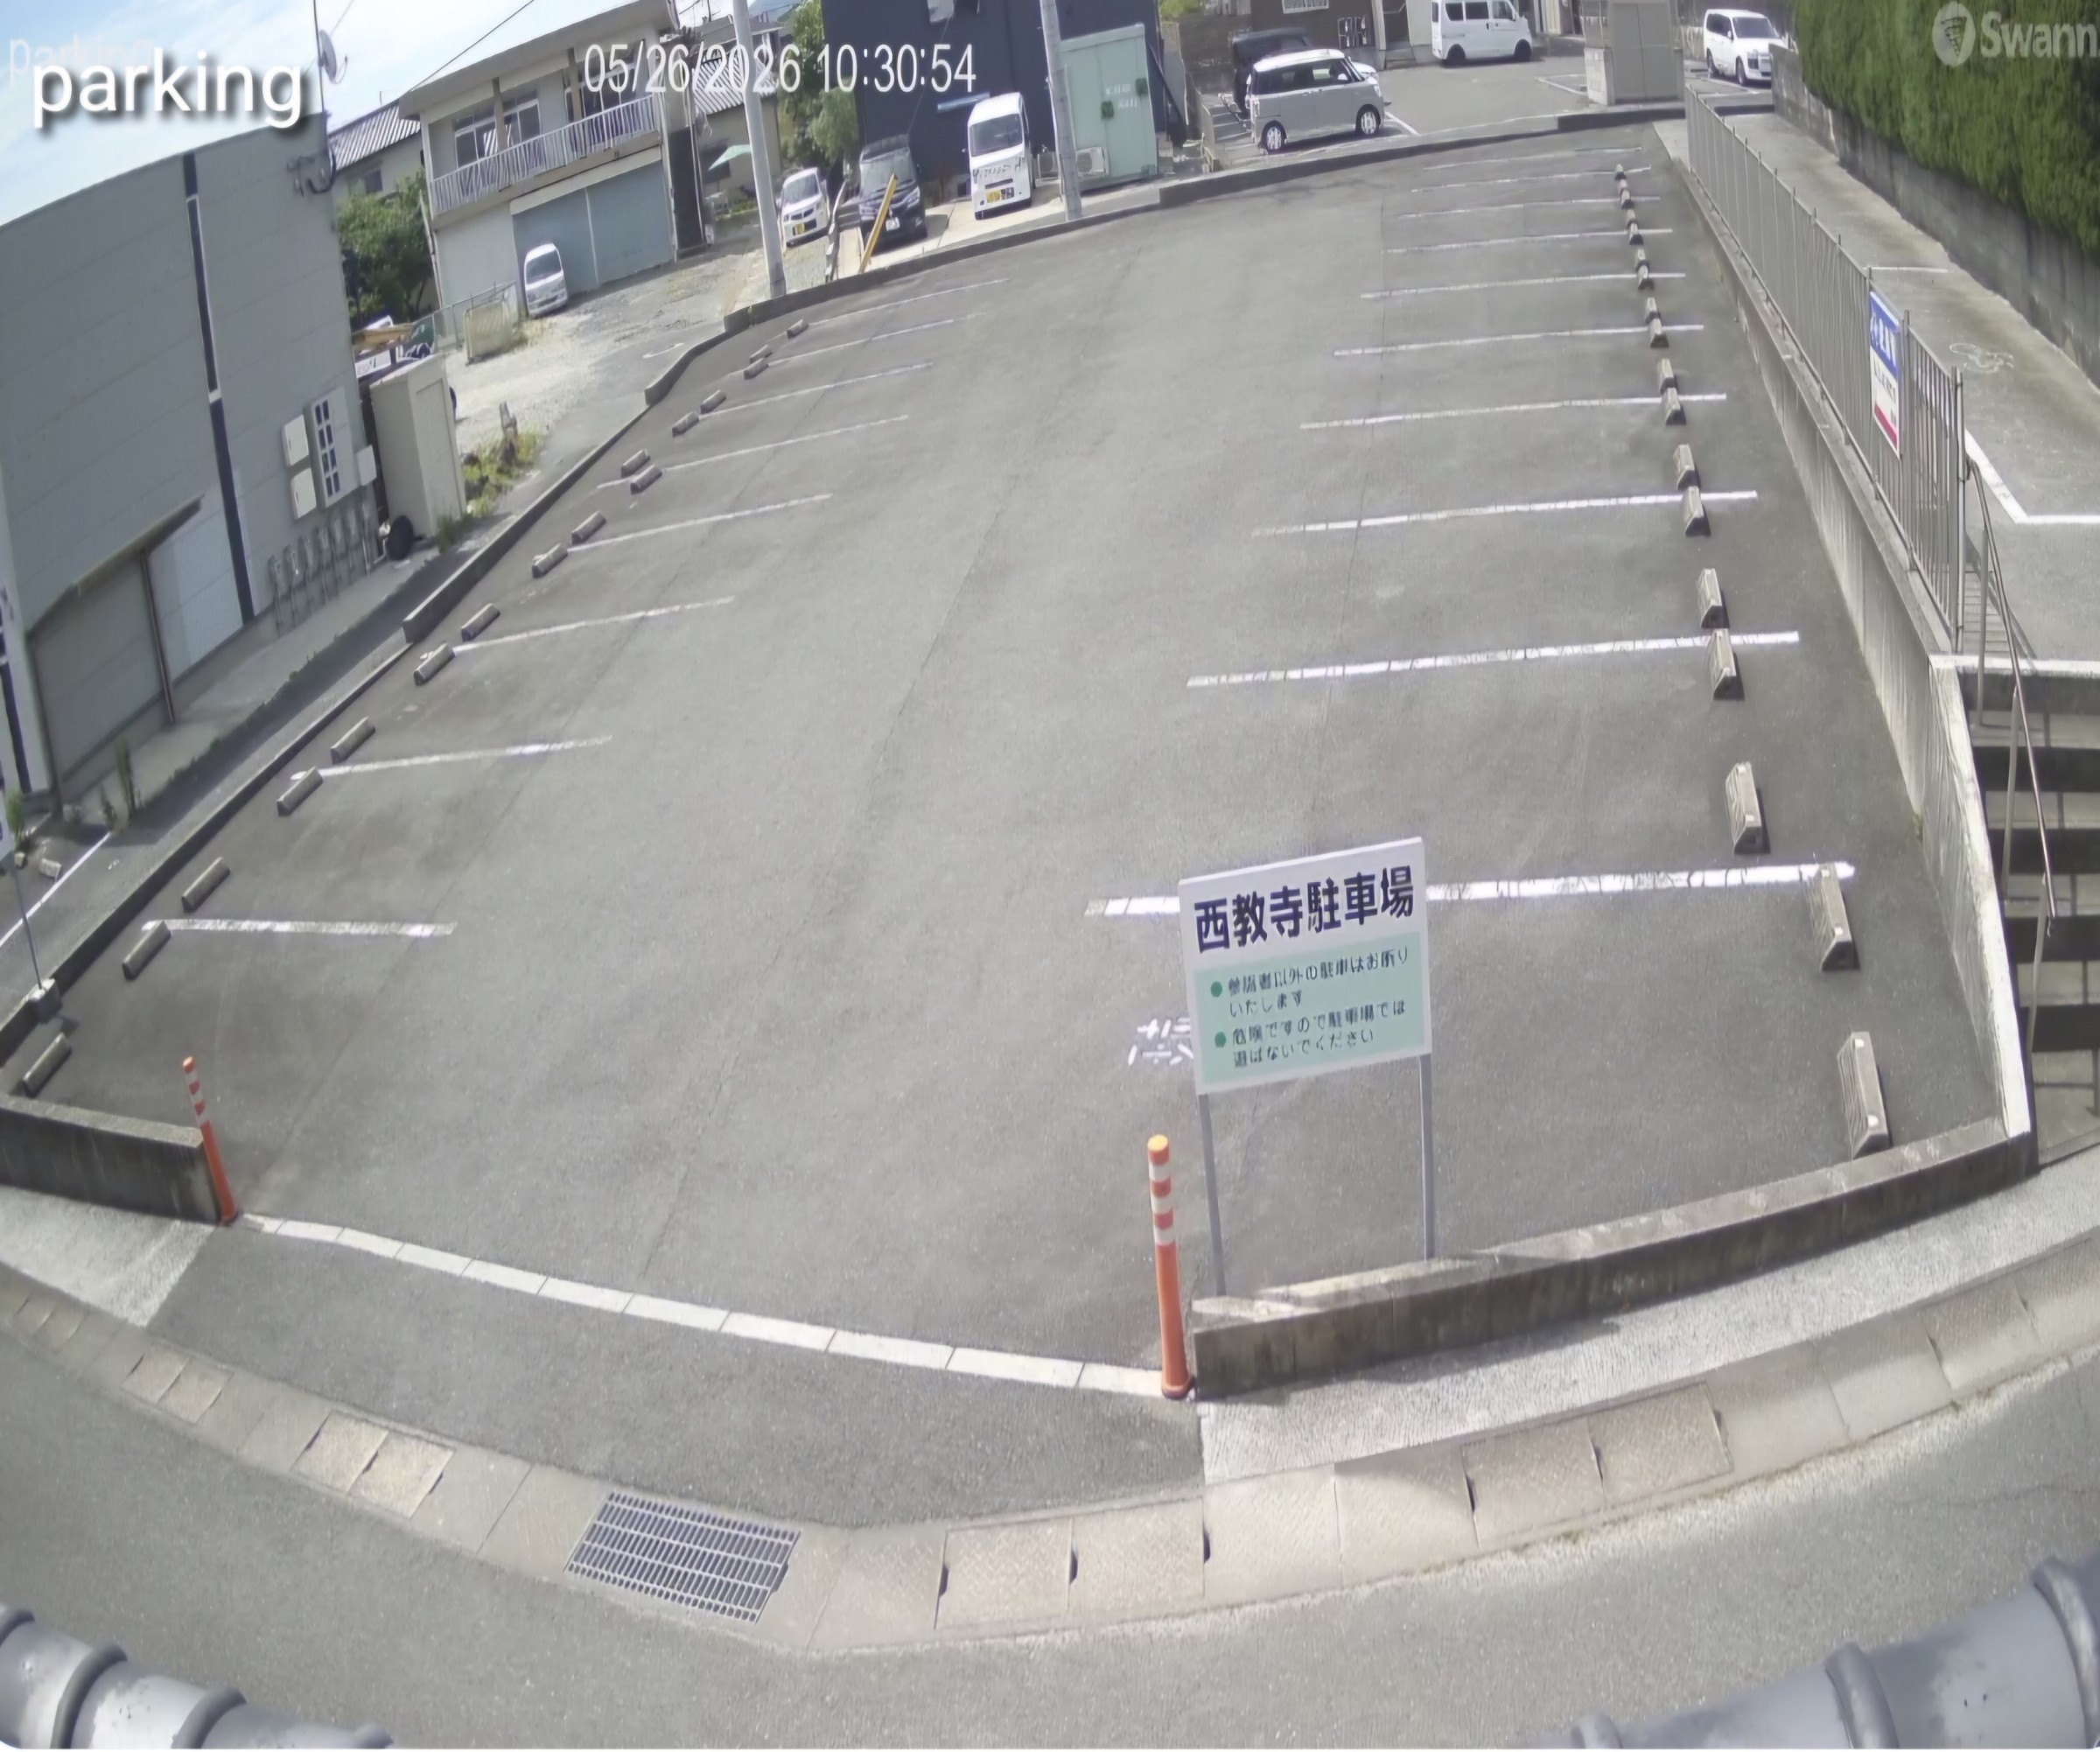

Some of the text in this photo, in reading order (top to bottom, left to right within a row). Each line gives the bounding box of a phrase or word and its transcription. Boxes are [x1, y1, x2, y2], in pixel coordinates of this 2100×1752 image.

[1194, 865, 1415, 954] 西教寺駐車場
[1229, 989, 1303, 1019] いたします
